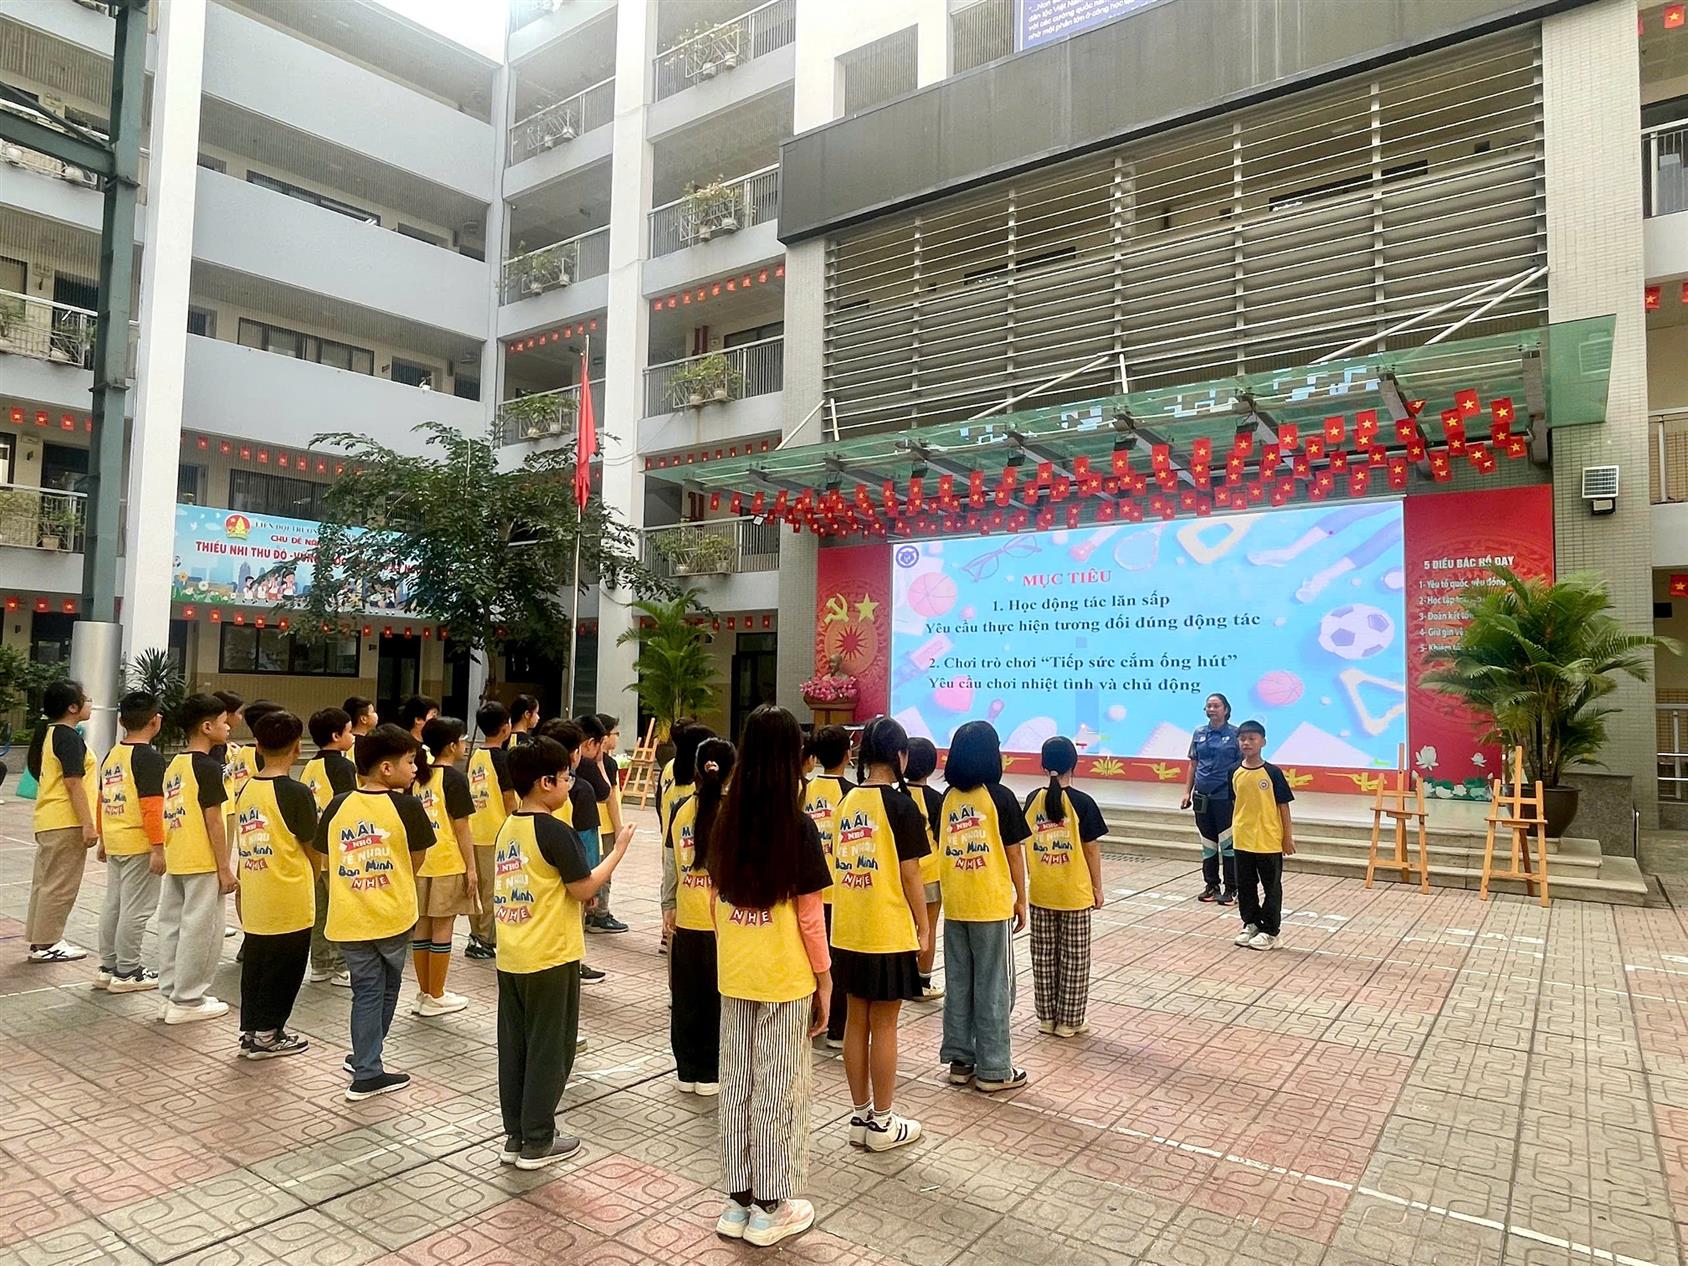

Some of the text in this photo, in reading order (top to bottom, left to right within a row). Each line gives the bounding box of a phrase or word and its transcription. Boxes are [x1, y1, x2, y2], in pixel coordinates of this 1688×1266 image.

[229, 545, 248, 556] NHI
[1424, 560, 1430, 570] 5
[1023, 568, 1112, 588] MỤC TIÊU
[993, 590, 1170, 613] 1. Học động tác lăn sấp
[925, 622, 950, 634] Yêu
[983, 621, 1014, 635] thực
[1019, 619, 1049, 634] hiện
[1055, 619, 1100, 633] tương
[1105, 614, 1130, 629] đối
[1135, 616, 1178, 630] đúng
[1183, 614, 1227, 630] động
[1233, 612, 1261, 626] tác
[929, 657, 940, 669] 2.
[944, 657, 976, 668] Chơi
[981, 657, 1001, 668] trò
[1006, 656, 1036, 668] chơi
[1088, 656, 1115, 668] sức
[1120, 652, 1154, 668] cắm
[1160, 652, 1192, 671] ống
[929, 677, 954, 689] Yêu
[986, 678, 1016, 689] chơi
[1022, 678, 1058, 692] nhiệt
[1063, 678, 1093, 690] tình
[1100, 678, 1117, 690] và
[1122, 678, 1152, 690] chủ
[1158, 678, 1201, 693] động
